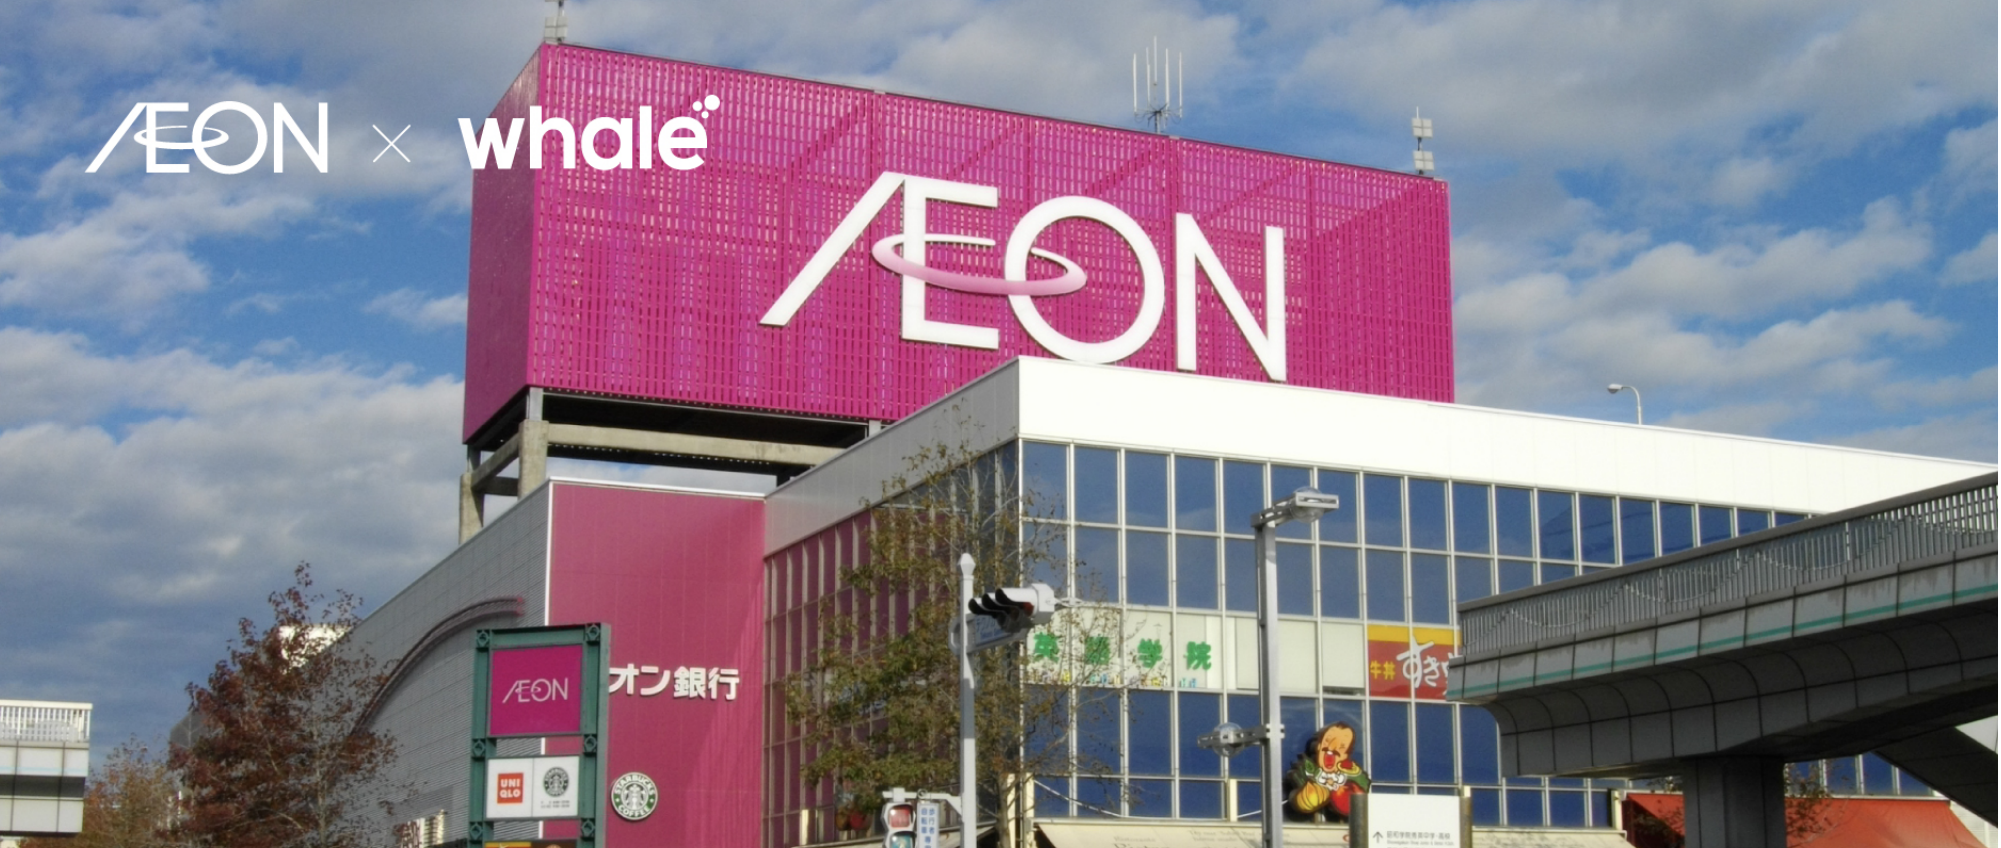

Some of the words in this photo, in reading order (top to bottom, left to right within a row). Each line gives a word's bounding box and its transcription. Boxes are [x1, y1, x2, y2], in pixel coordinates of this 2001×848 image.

[1396, 634, 1450, 690] すき
[500, 778, 521, 788] UNI
[614, 774, 656, 795] STARBUCKS
[500, 789, 521, 798] QLO
[618, 804, 650, 817] COFFEE
